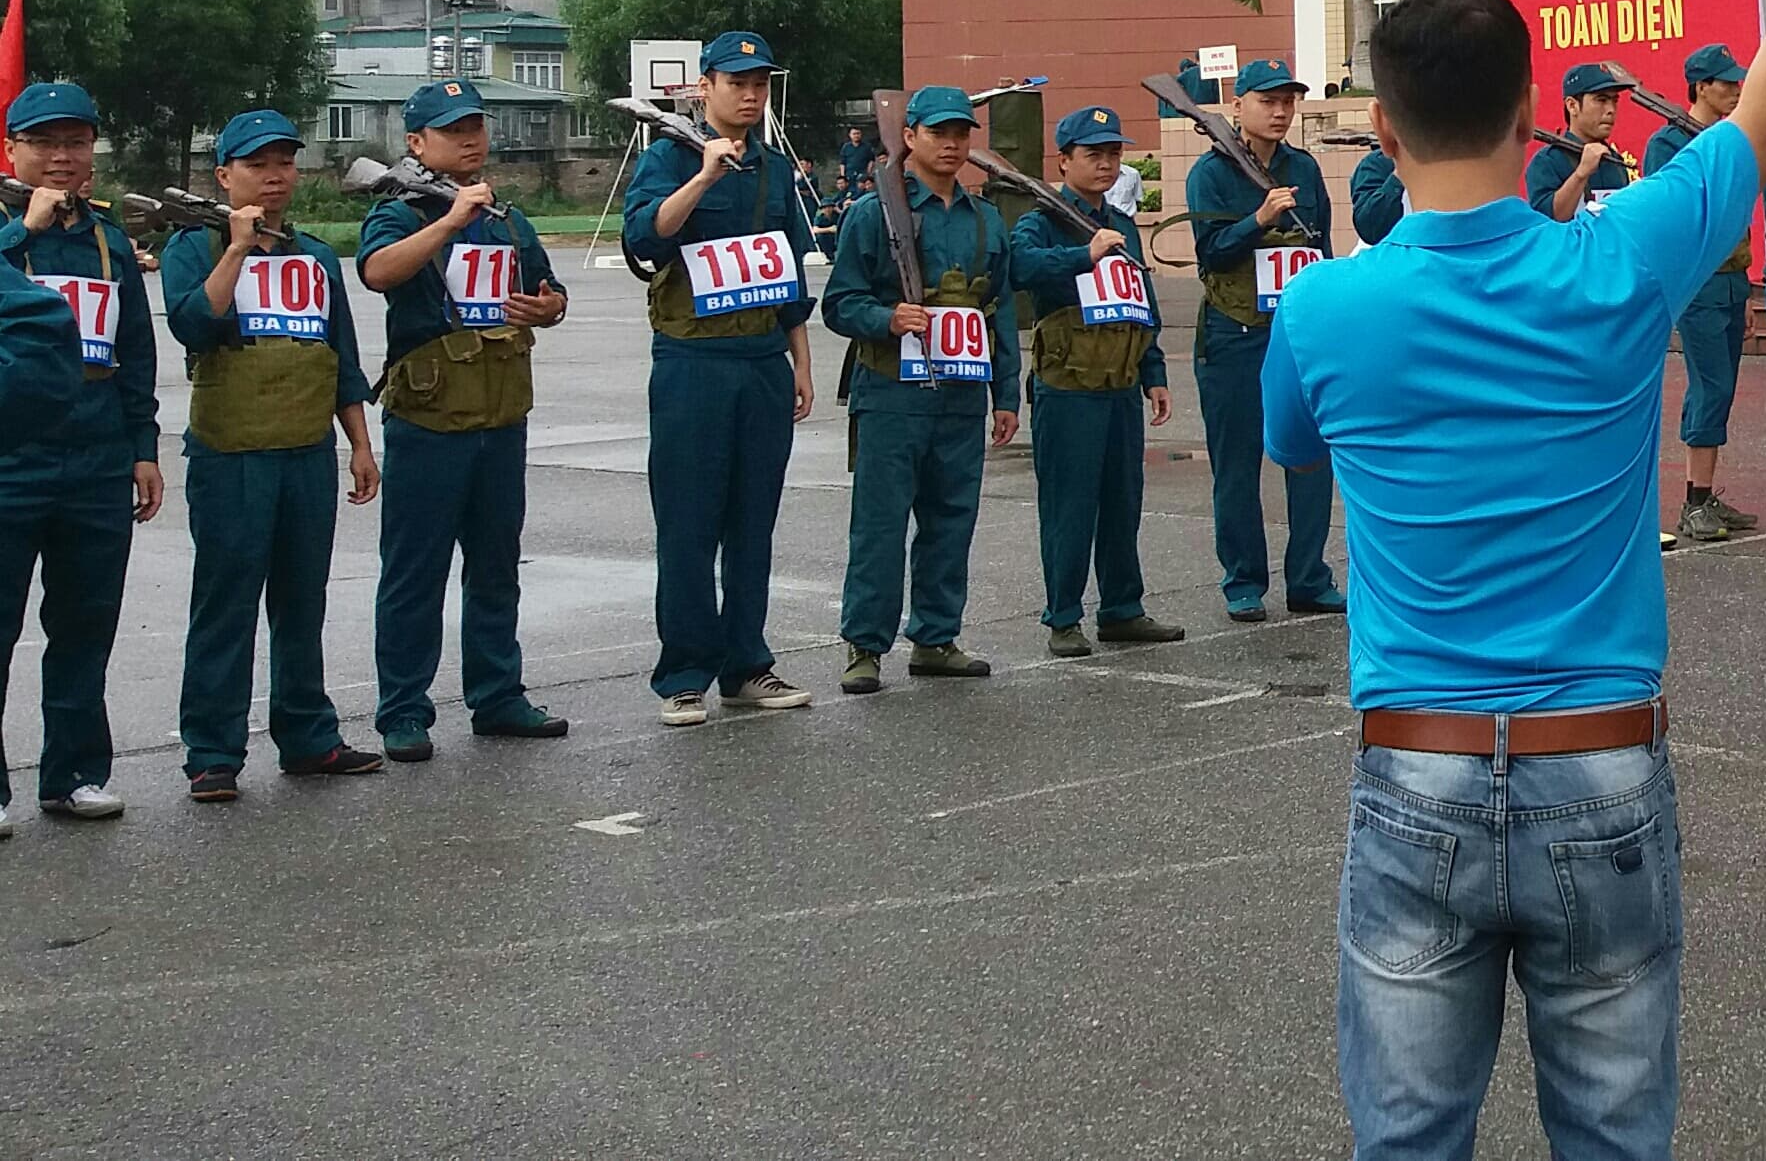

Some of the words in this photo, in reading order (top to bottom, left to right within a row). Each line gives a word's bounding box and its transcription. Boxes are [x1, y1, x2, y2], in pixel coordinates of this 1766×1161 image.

[697, 236, 784, 288] 113
[1093, 259, 1144, 303] 105
[1267, 250, 1319, 291] 10
[249, 258, 325, 312] 108
[706, 295, 736, 310] BA
[740, 286, 789, 305] ĐÌNH
[33, 280, 110, 336] 17
[248, 318, 281, 330] BA
[1093, 307, 1119, 320] BA
